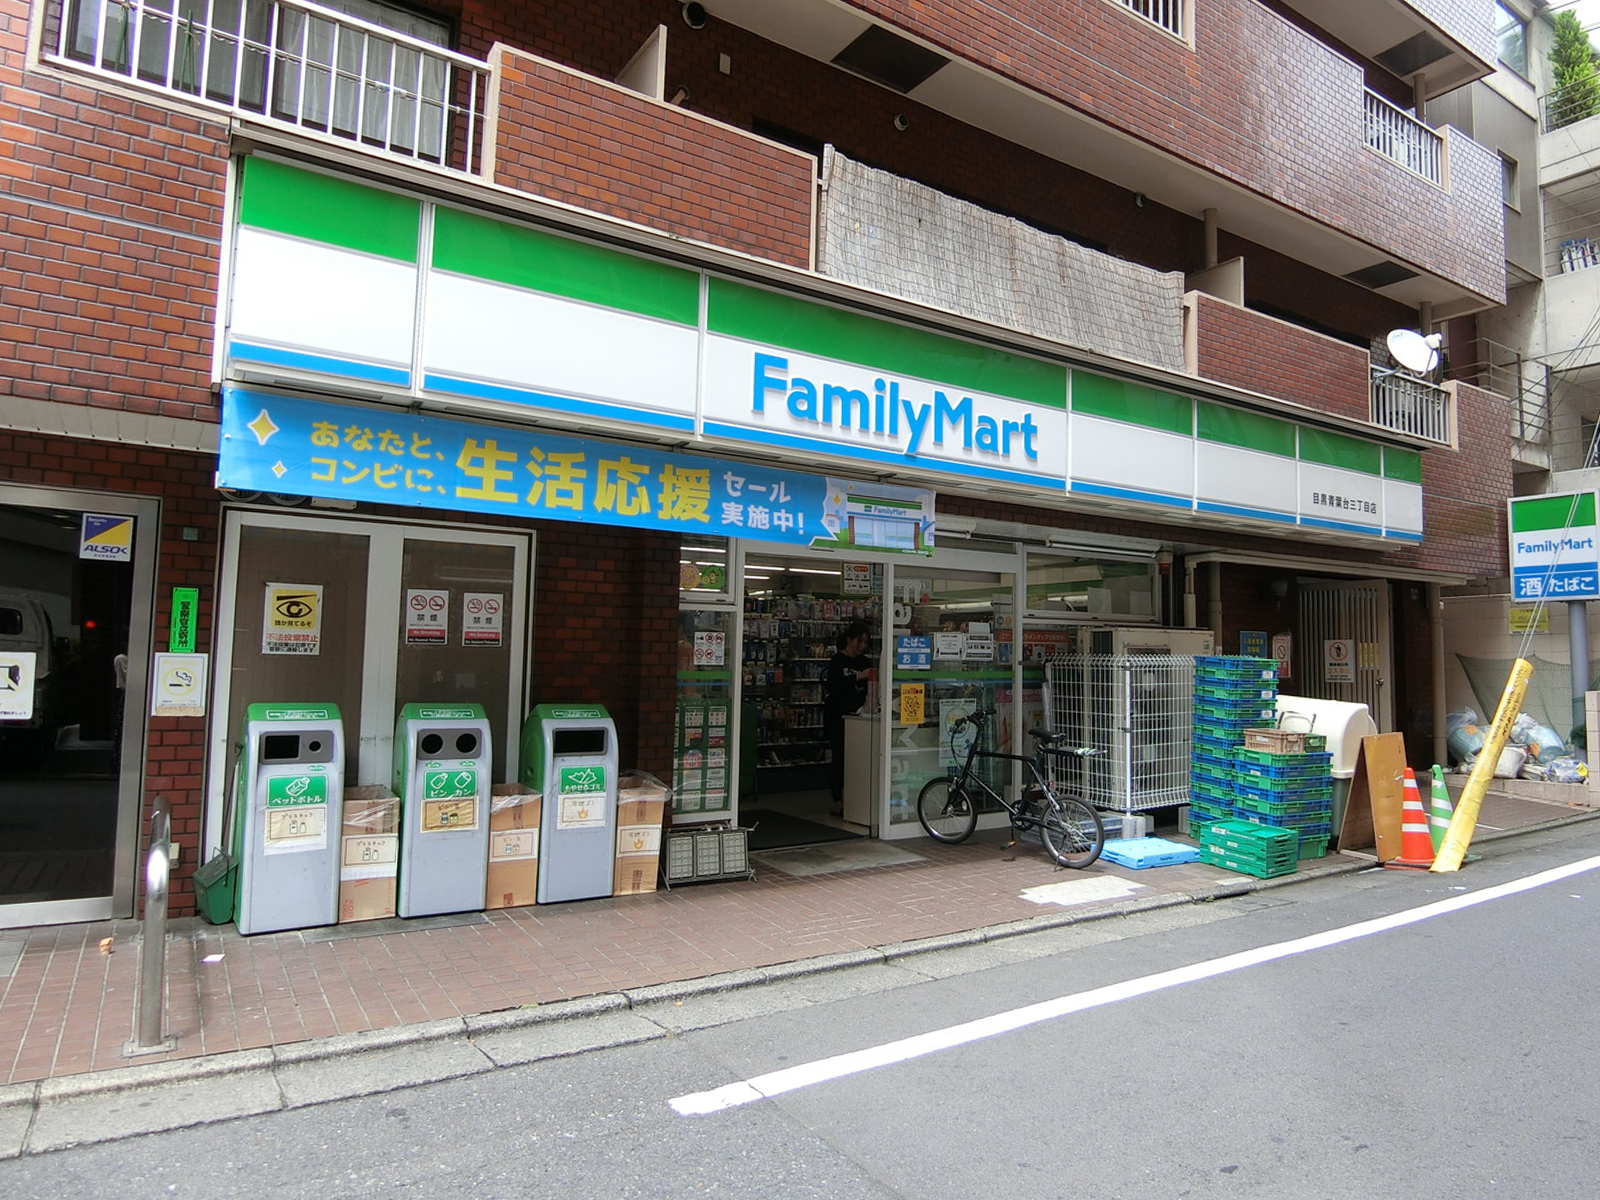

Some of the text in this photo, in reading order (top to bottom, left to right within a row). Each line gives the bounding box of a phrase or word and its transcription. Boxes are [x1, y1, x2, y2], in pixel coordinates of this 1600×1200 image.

[753, 352, 1037, 458] FamilyMart
[311, 420, 445, 461] あなたと、
[311, 456, 446, 495] コンビに、
[456, 439, 710, 523] 生活応援
[722, 471, 791, 503] セール
[873, 506, 907, 517] FamilyMart
[1313, 492, 1377, 514] 目黒青葉台三丁目店
[84, 544, 129, 555] ALSOK
[1517, 538, 1593, 554] FamilyMart
[1520, 577, 1595, 597] 酒 たばこ
[902, 637, 926, 648] たばこ
[272, 795, 322, 805] ペットボトル
[431, 789, 471, 798] ビン カン
